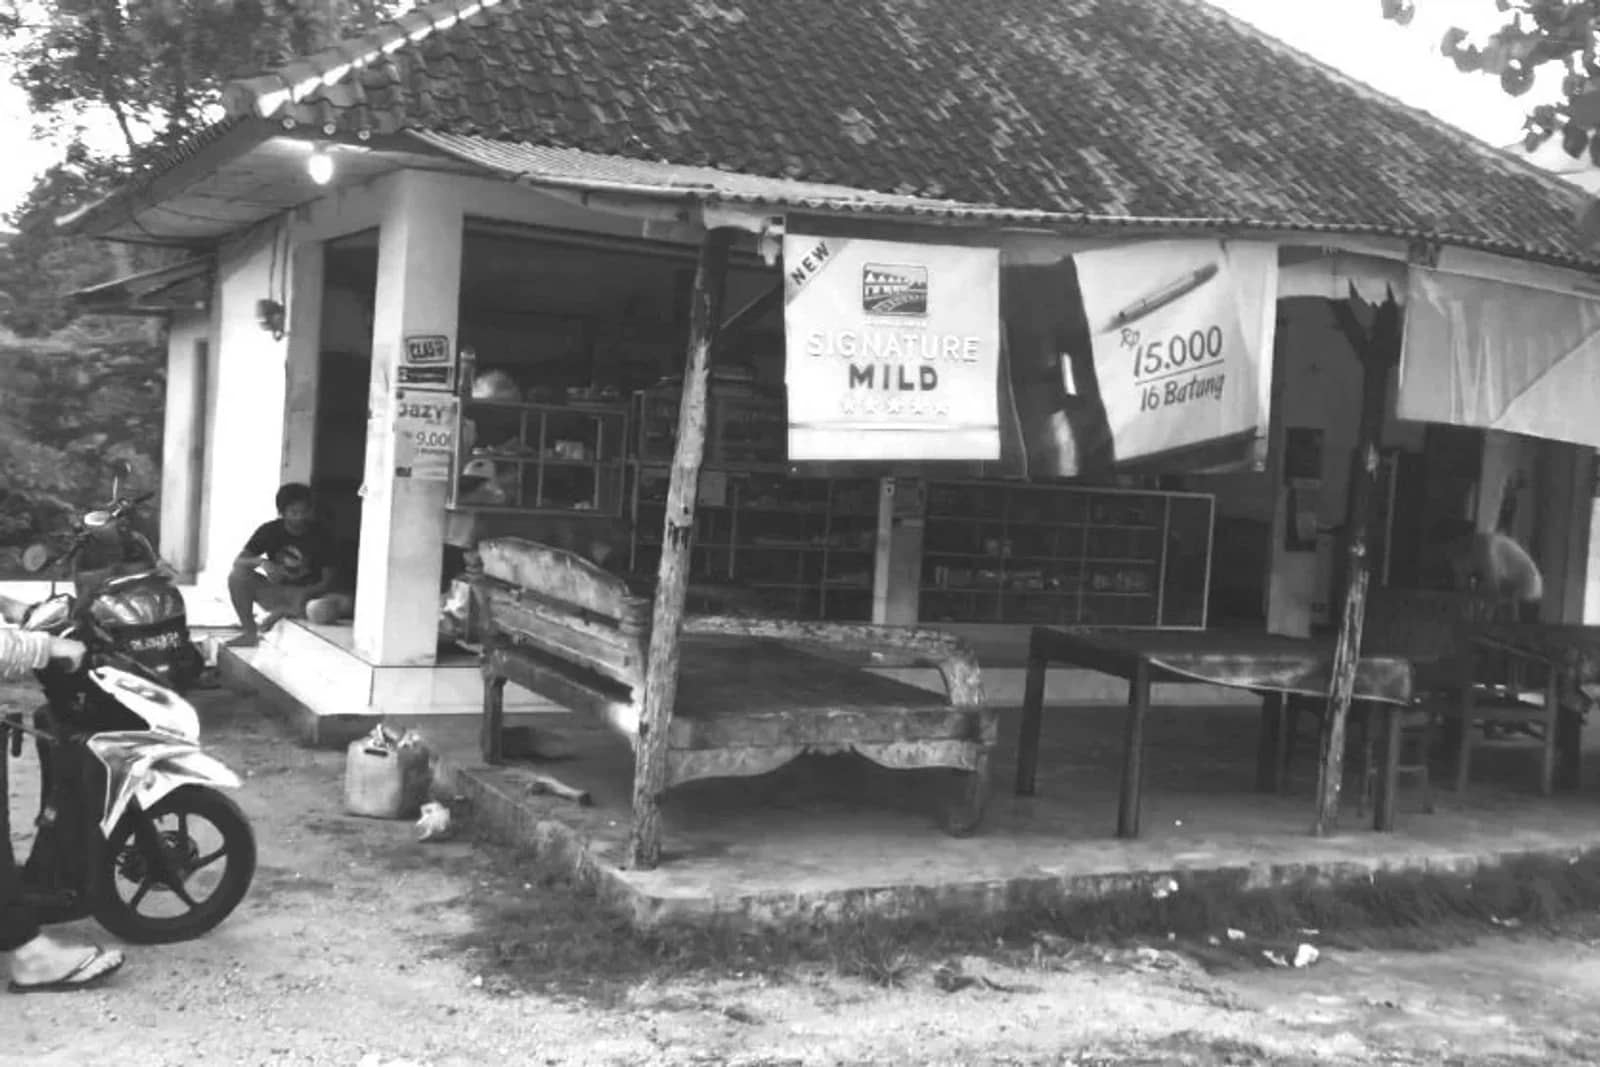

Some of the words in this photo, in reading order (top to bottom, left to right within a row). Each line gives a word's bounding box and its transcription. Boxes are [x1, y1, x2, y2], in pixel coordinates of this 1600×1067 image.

[791, 240, 829, 285] NEW
[808, 331, 981, 363] SIGNATURE
[1120, 328, 1141, 351] Rp
[1133, 325, 1223, 377] 15.000
[849, 363, 938, 391] MILD
[1140, 386, 1160, 412] 16
